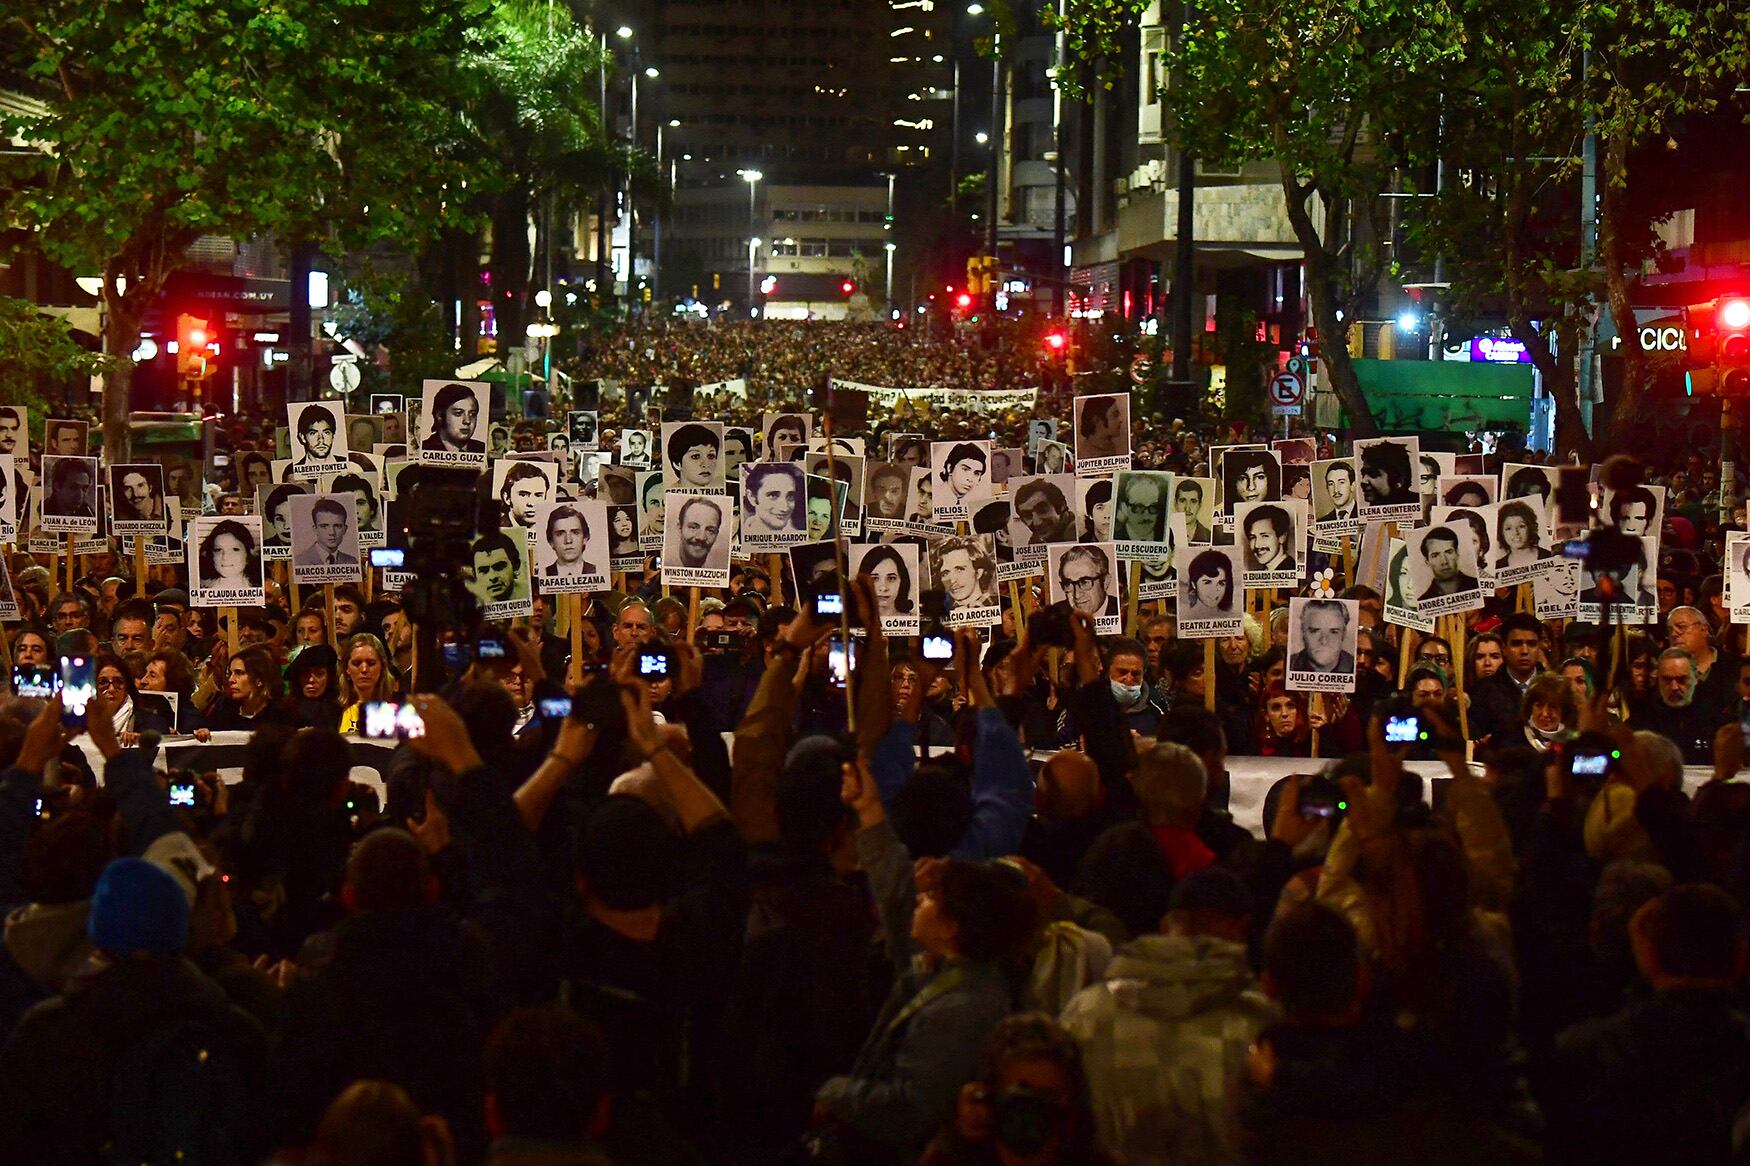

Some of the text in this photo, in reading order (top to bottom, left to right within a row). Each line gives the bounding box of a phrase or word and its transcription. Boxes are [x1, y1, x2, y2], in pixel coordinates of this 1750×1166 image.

[422, 452, 484, 463] CARLOS GUAZ
[1077, 457, 1130, 469] JÚPITER DELPINO
[294, 463, 348, 474] ALBERTO FONTELA
[700, 488, 725, 496] TRIAS
[934, 506, 962, 514] HELIOS
[1360, 504, 1421, 516] ELENA QUINTEROS
[70, 518, 78, 526] de
[80, 518, 96, 526] LEÓN
[1316, 522, 1348, 531] FRANCISCO
[2, 526, 14, 534] RÍO
[640, 536, 661, 544] ALBERTO
[744, 534, 772, 542] ENRIQUE
[145, 544, 167, 552] SEVERO
[1131, 544, 1168, 554] ESCUDERO
[295, 566, 360, 576] MARCOS AROCENA
[664, 568, 728, 578] WINSTON MAZZUCHI
[540, 576, 606, 587] RAFAEL LEZAMA
[208, 590, 237, 598] CLAUDIA
[238, 587, 264, 598] GARCÍA
[1447, 591, 1480, 605] CARNEIRO
[1538, 602, 1578, 613] ABEL AY
[1636, 608, 1655, 616] RTE
[966, 608, 1000, 620] AROCENA
[886, 618, 918, 628] GÓMEZ
[1180, 620, 1242, 630] BEATRIZ ANGLET
[1289, 673, 1354, 684] JULIO CORREA
